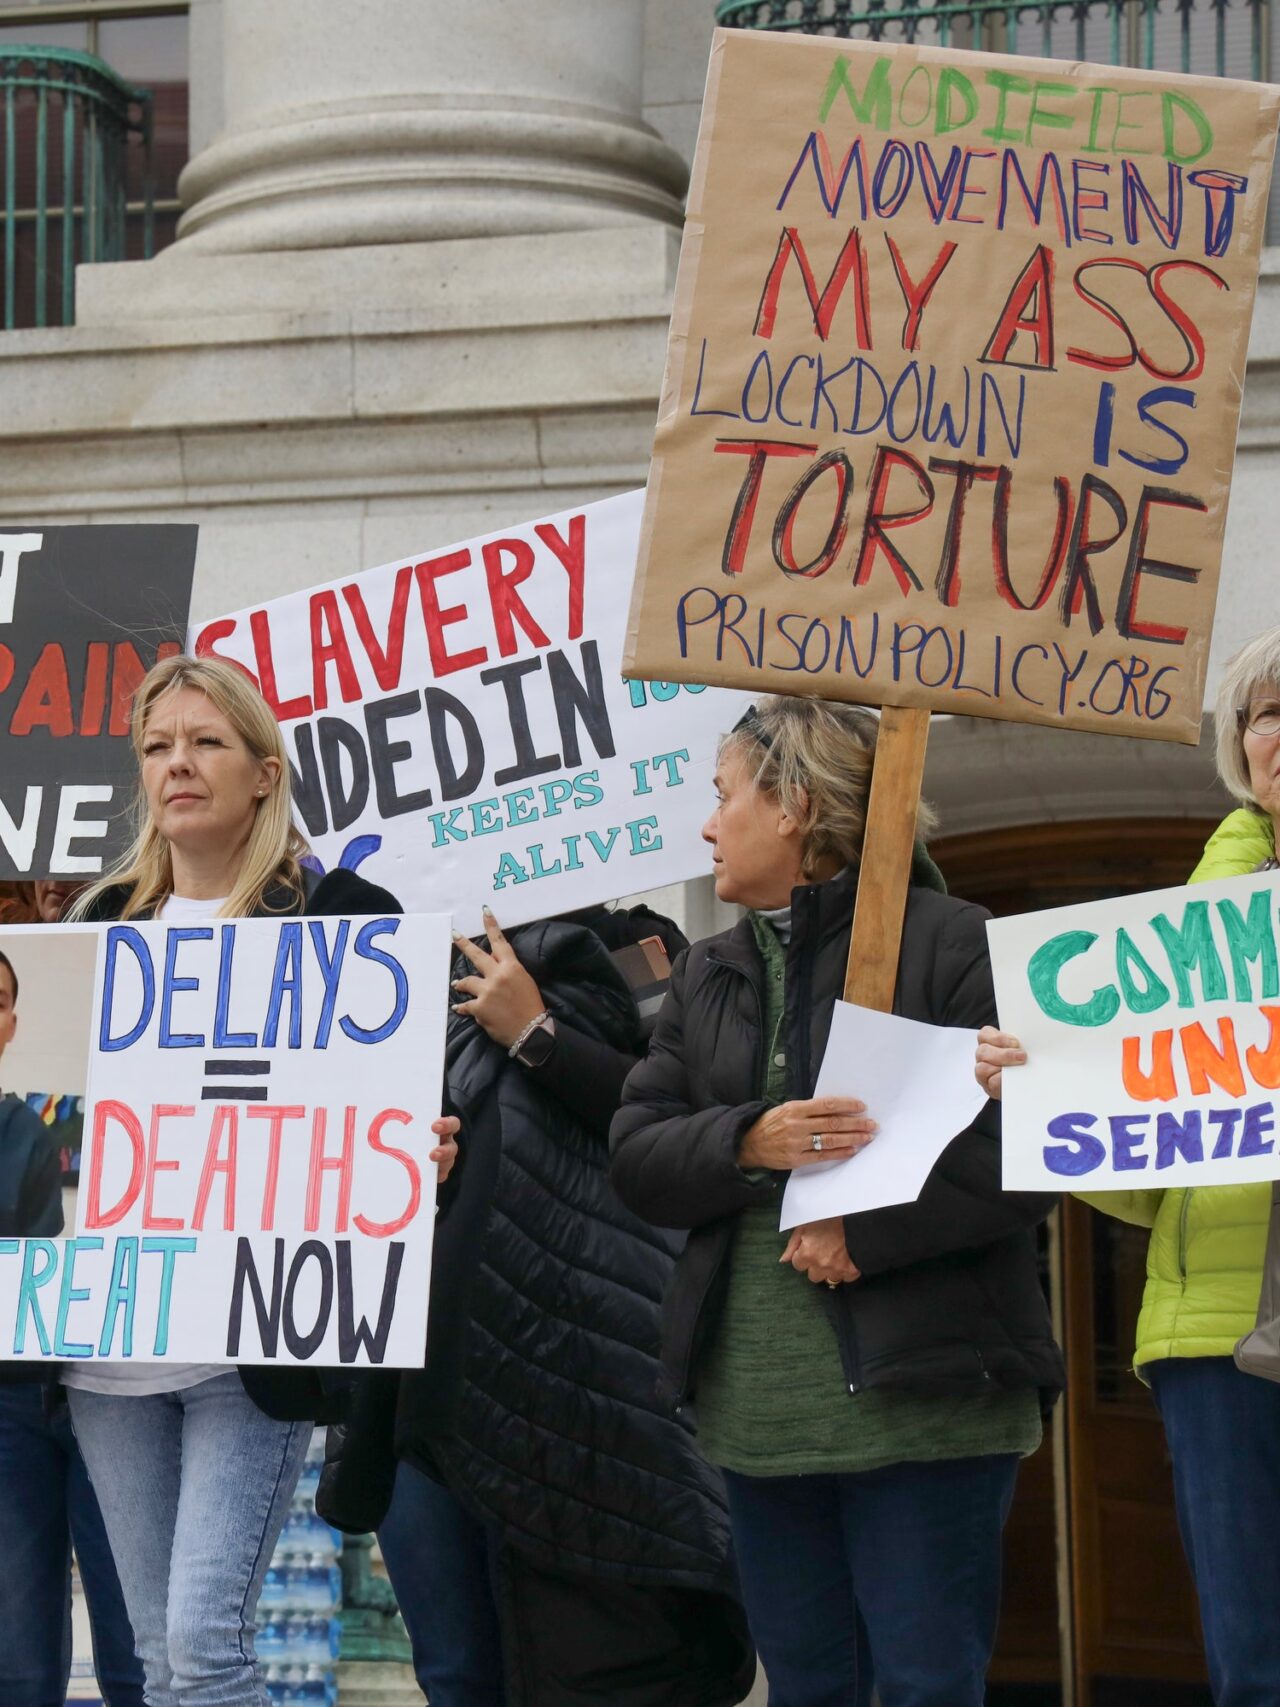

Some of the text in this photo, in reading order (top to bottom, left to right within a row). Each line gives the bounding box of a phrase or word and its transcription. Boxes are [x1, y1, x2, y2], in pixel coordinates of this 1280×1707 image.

[818, 54, 1215, 167] MODIFIED
[776, 130, 1249, 258] MOVEMENT
[753, 225, 1230, 382] MY ASS
[690, 338, 1198, 476] LOCKDOWN IS
[713, 438, 1208, 646] TORTURE
[195, 514, 586, 722] SLAVERY
[290, 640, 616, 838] NDED IN
[428, 748, 692, 848] KEEPS IT
[492, 815, 663, 891] ALIVE
[99, 917, 410, 1053] DELAYS
[1027, 888, 1280, 1027] COMM
[84, 1099, 422, 1236] DEATHS
[1043, 1101, 1280, 1176] SENTE
[226, 1237, 405, 1364] NOW
